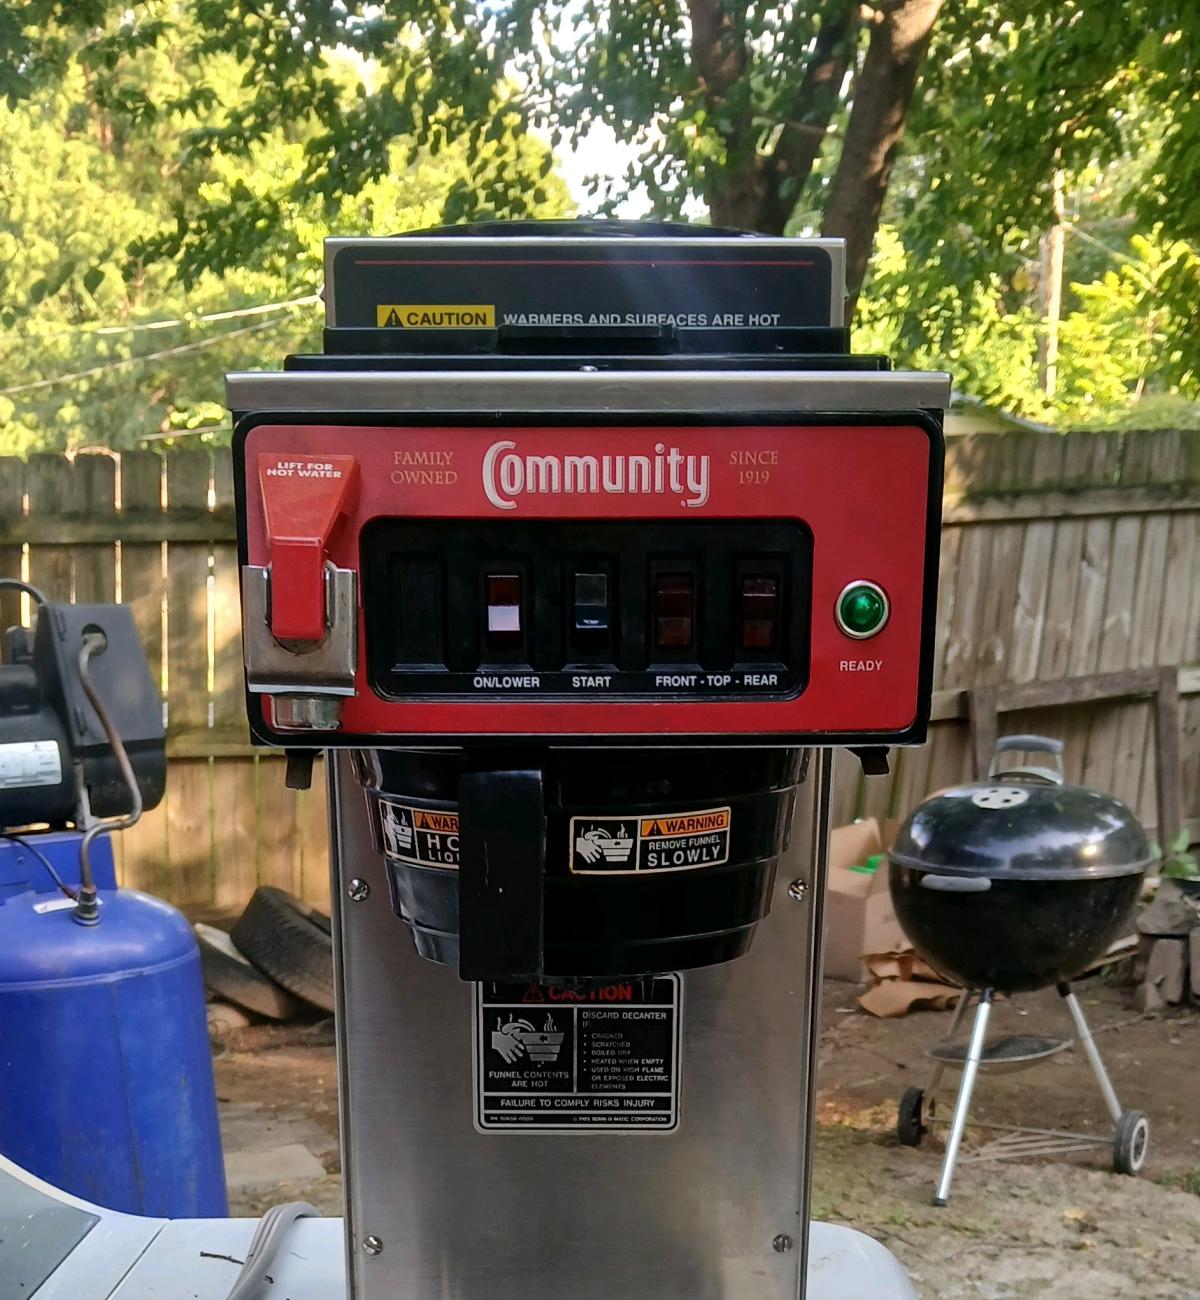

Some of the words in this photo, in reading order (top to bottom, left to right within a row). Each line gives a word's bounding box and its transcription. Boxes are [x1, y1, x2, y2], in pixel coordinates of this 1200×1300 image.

[406, 312, 487, 326] CAUTION
[503, 313, 584, 325] WARMERS
[588, 313, 621, 325] AND
[625, 313, 708, 326] SURFACES
[712, 313, 744, 326] ARE
[748, 313, 781, 326] HOT
[393, 450, 454, 467] FAMILY
[728, 450, 779, 465] SINCE
[277, 461, 304, 470] LIFT
[306, 462, 334, 471] FOR
[266, 468, 294, 477] HOT
[296, 469, 343, 479] WATER
[390, 470, 458, 485] OWNED
[482, 440, 711, 510] Community
[737, 470, 770, 485] 1919
[839, 660, 884, 672] READY
[473, 676, 541, 688] ON/LOWER
[571, 676, 612, 688] START
[655, 675, 698, 687] FRONT
[706, 675, 732, 687] TOP
[743, 674, 778, 686] REAR
[665, 814, 724, 833] WARNING
[648, 839, 688, 851] REMOVE
[688, 834, 721, 847] FUNNEL
[647, 845, 721, 867] SLOWLY
[582, 1011, 620, 1020] DISCARD
[622, 1011, 667, 1020] DECANTER
[488, 1071, 522, 1079] FUNNEL
[523, 1071, 569, 1079] CONTENTS
[511, 1080, 528, 1088] ARE
[531, 1080, 549, 1088] HOT
[500, 1098, 537, 1107] FAILURE
[540, 1098, 552, 1107] TO
[554, 1098, 590, 1107] COMPLY
[593, 1098, 620, 1107] RISKS
[623, 1099, 656, 1108] INJURY
